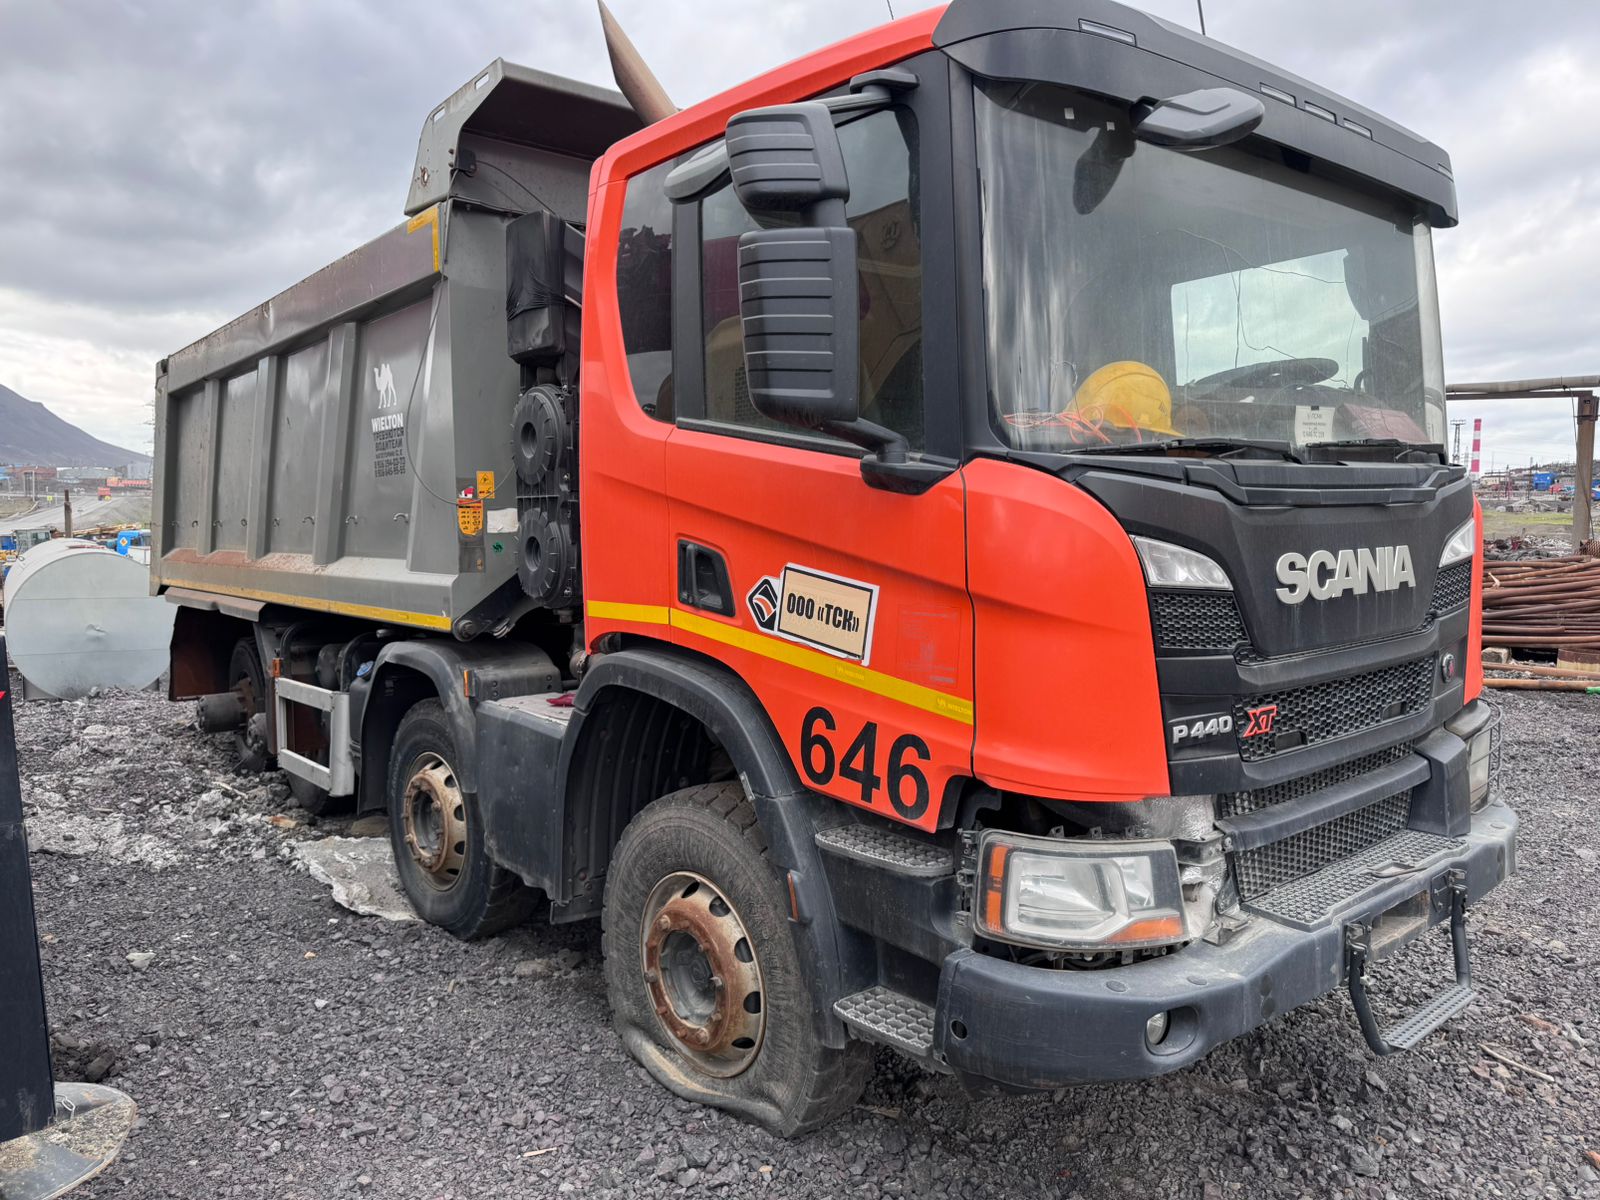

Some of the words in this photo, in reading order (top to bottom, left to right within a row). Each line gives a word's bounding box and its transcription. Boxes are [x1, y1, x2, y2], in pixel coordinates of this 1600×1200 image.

[371, 413, 404, 433] WIELTON
[1276, 544, 1417, 605] SCANIA
[787, 592, 816, 620] ООО
[1242, 705, 1278, 738] XT
[800, 706, 931, 820] 646
